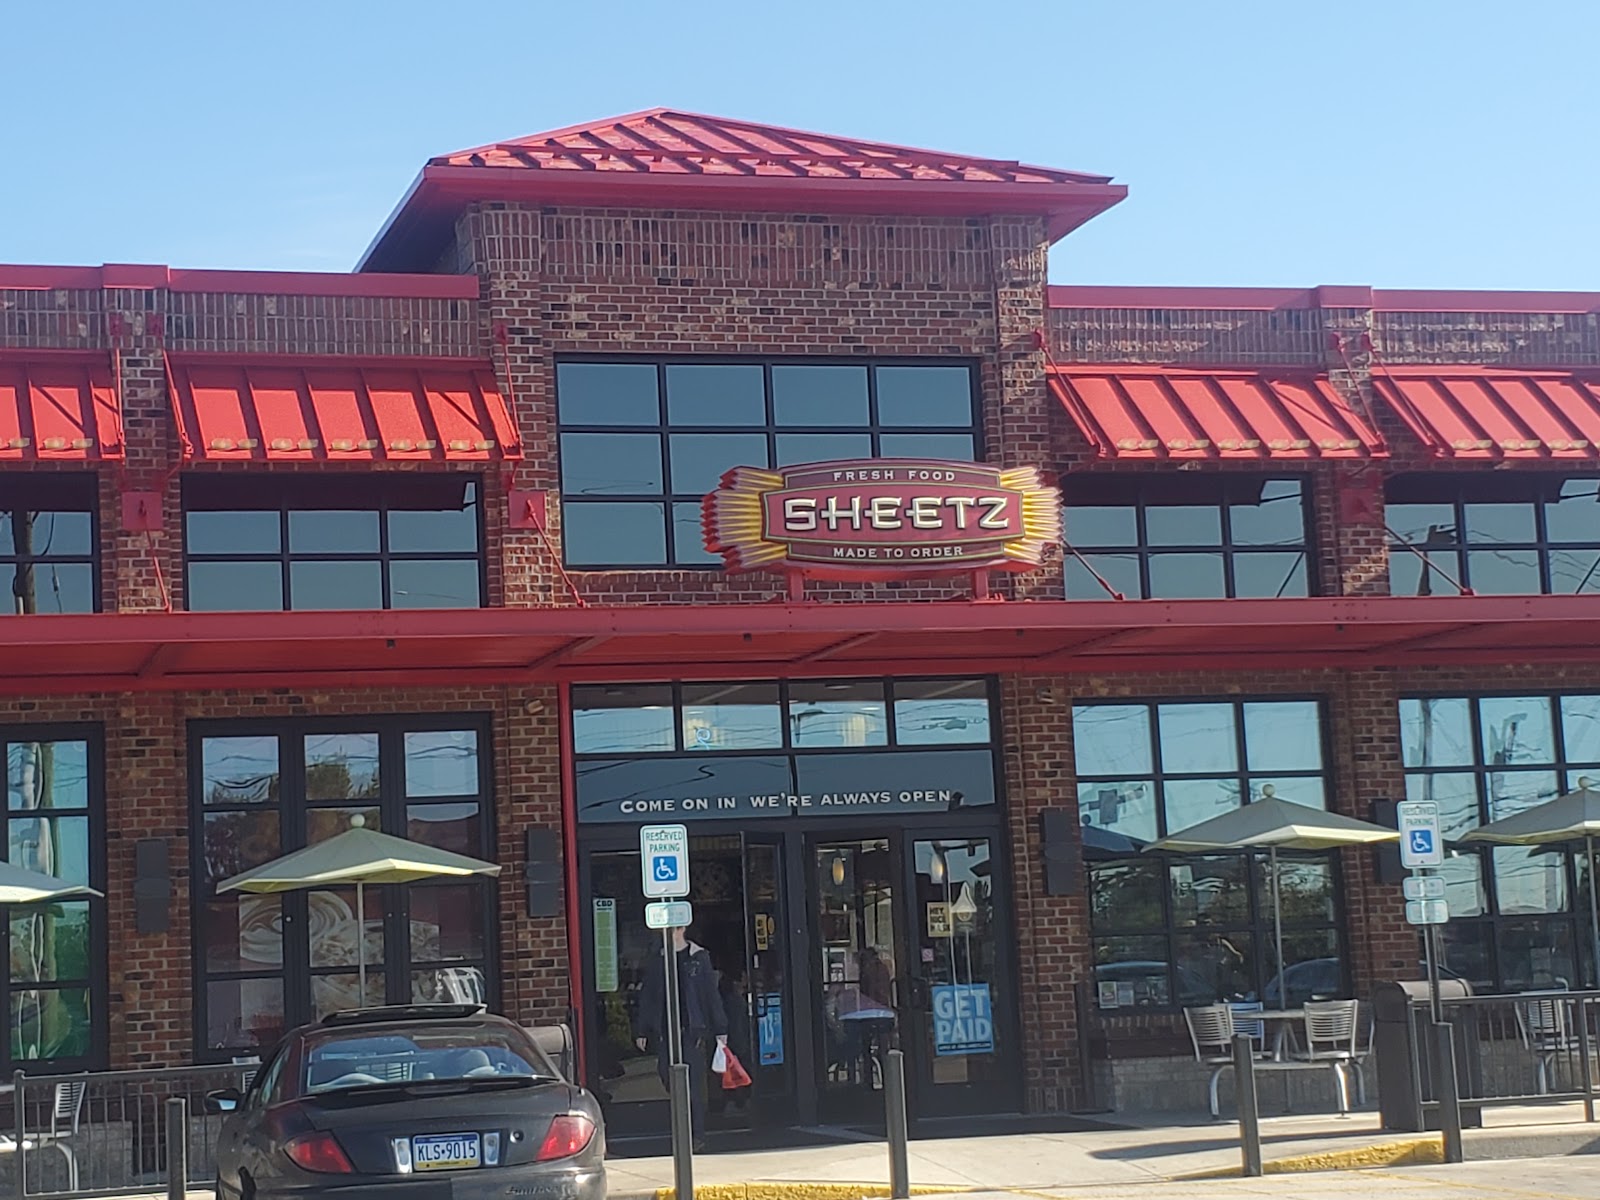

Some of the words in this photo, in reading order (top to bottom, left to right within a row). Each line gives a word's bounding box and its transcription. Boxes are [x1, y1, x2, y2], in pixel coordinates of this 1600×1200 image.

[833, 470, 895, 482] FRESH
[908, 470, 956, 482] FOOD
[784, 495, 1010, 531] SHEETZ
[833, 547, 878, 559] MADE
[884, 547, 904, 558] TO
[910, 546, 964, 558] ORDER
[619, 799, 676, 814] COME
[682, 798, 709, 811] ON
[717, 797, 737, 809] IN
[750, 791, 813, 808] WE'RE
[820, 791, 892, 806] ALWAYS
[899, 789, 951, 802] OPEN
[645, 830, 683, 842] RESERVED
[649, 842, 680, 854] PARKING
[934, 989, 987, 1019] GET
[937, 1018, 991, 1044] PAID
